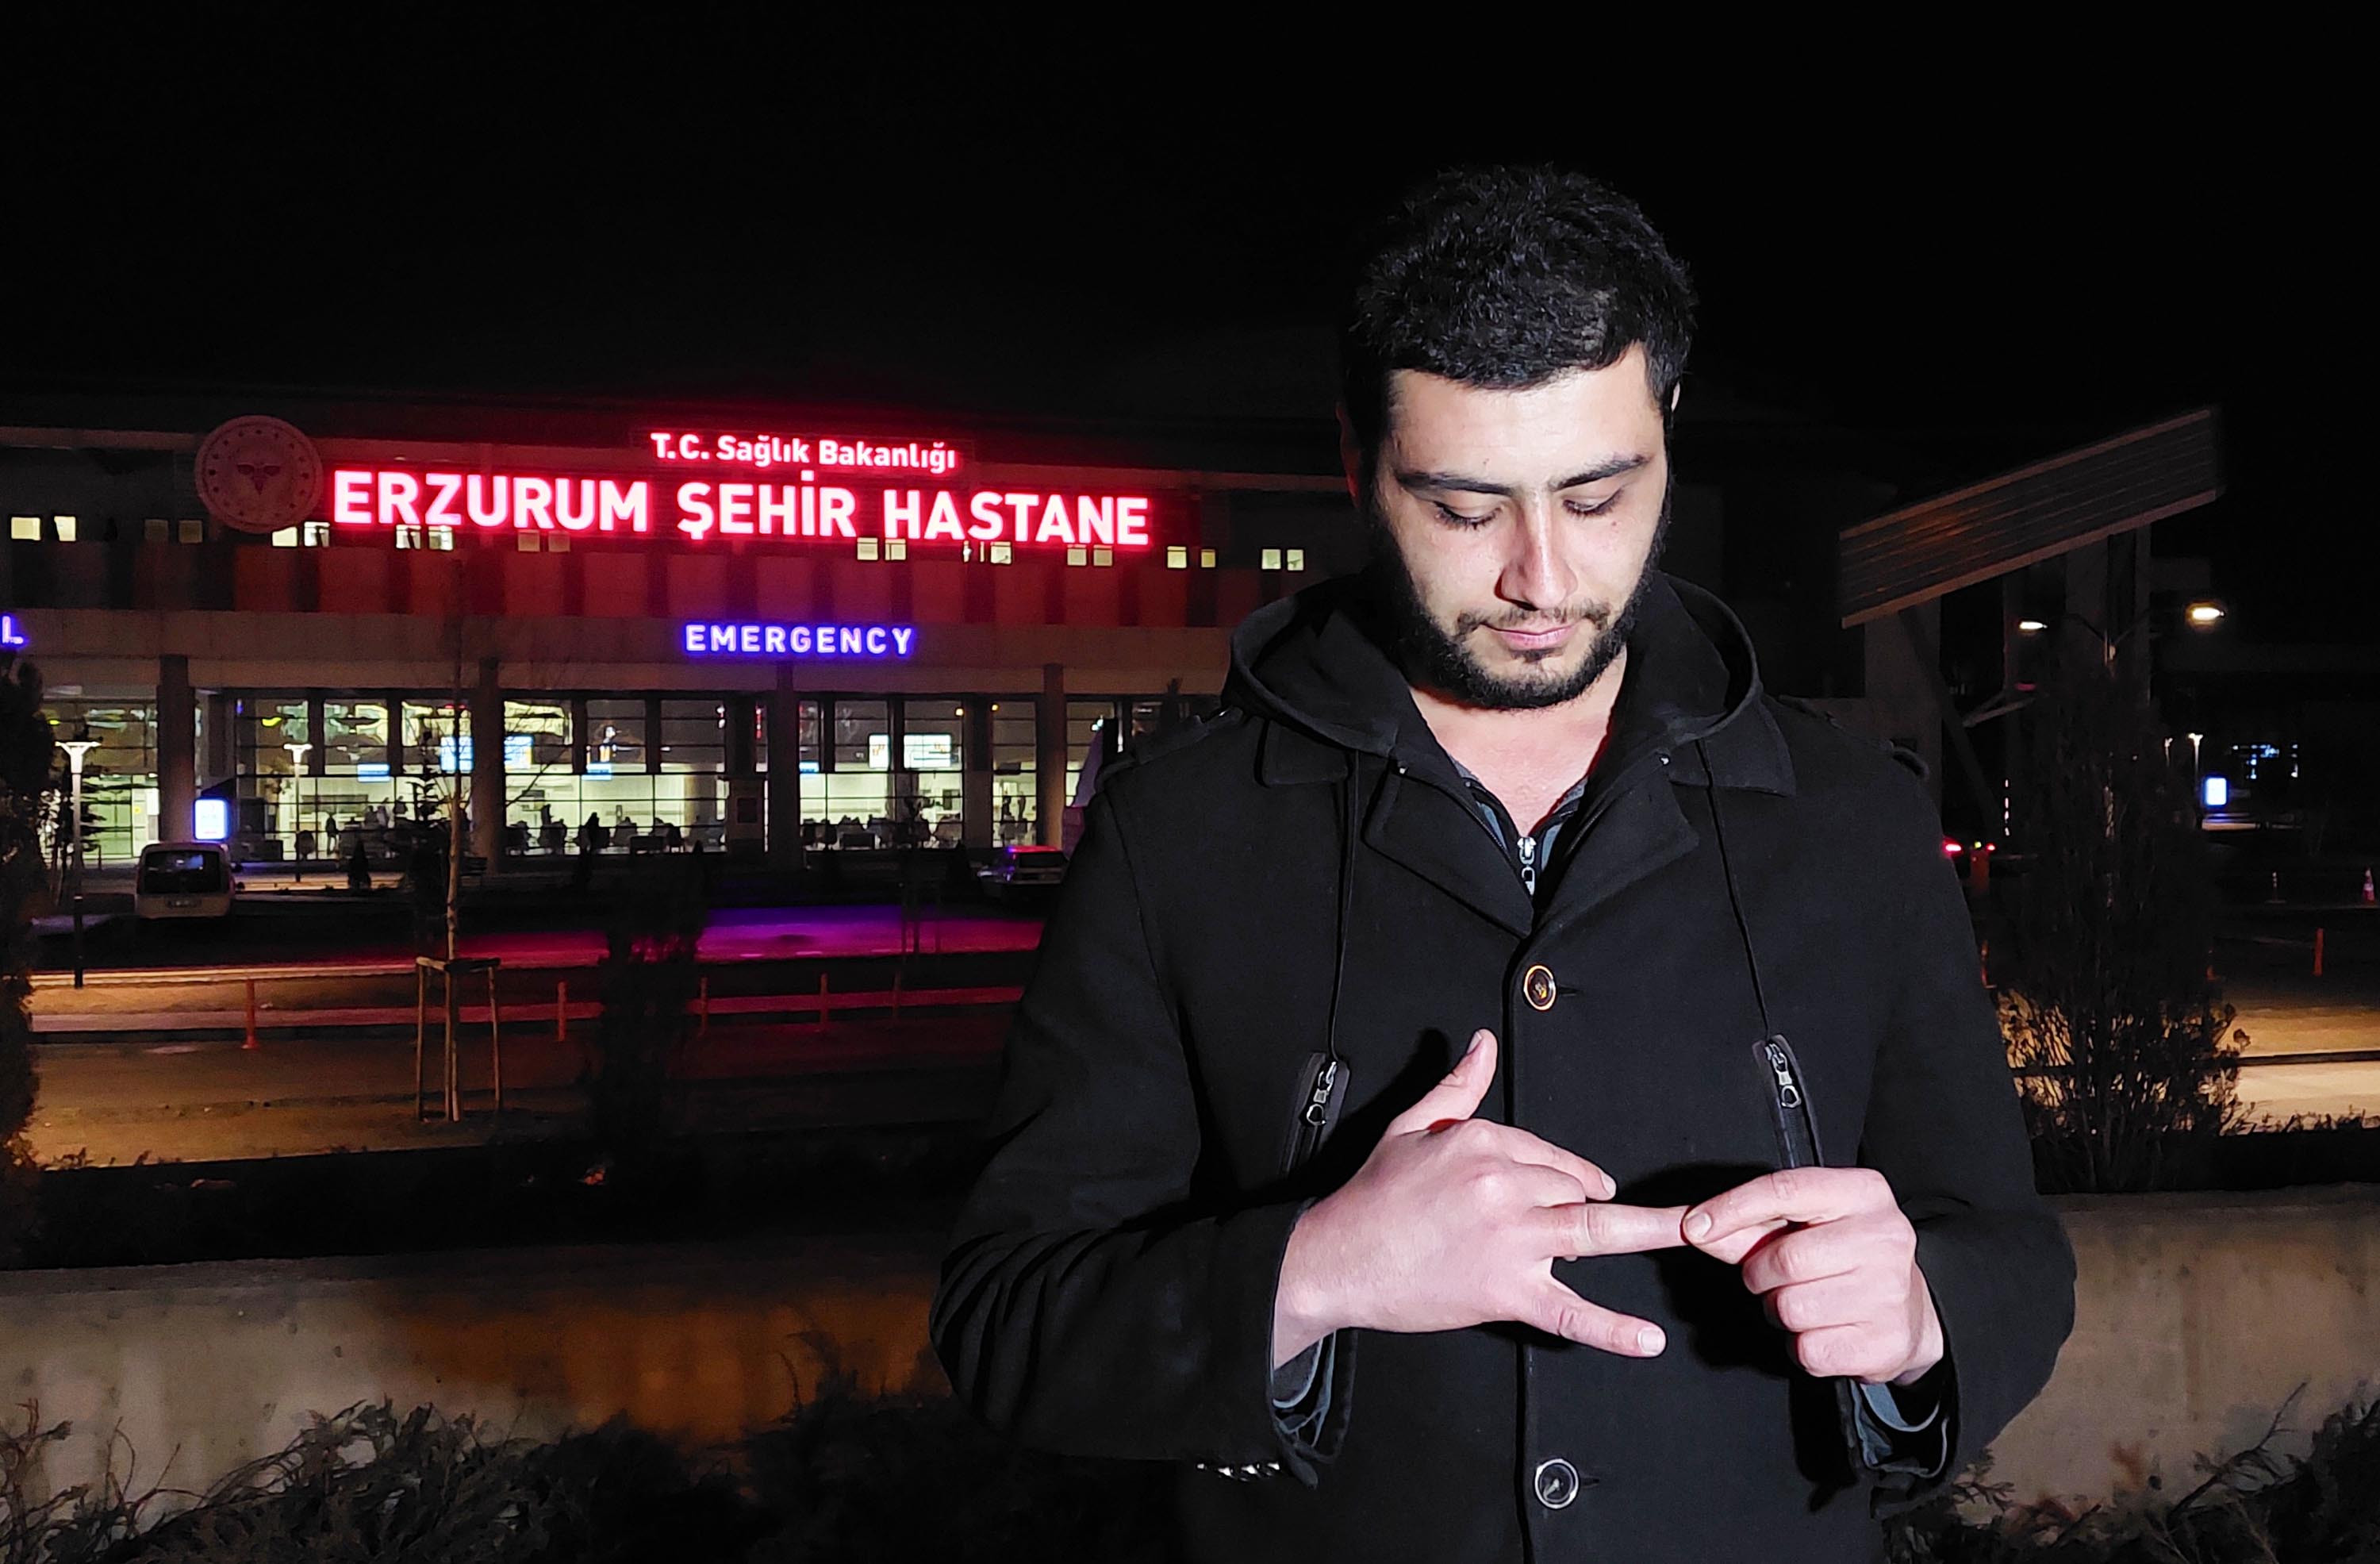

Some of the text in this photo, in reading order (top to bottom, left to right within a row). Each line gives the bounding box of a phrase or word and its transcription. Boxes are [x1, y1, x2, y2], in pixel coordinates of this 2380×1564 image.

[650, 432, 959, 474] T.C. Sağlık Bakanlığı
[333, 470, 1150, 546] ERZURUM ŞEHİR HASTANE
[685, 624, 912, 655] EMERGENCY
